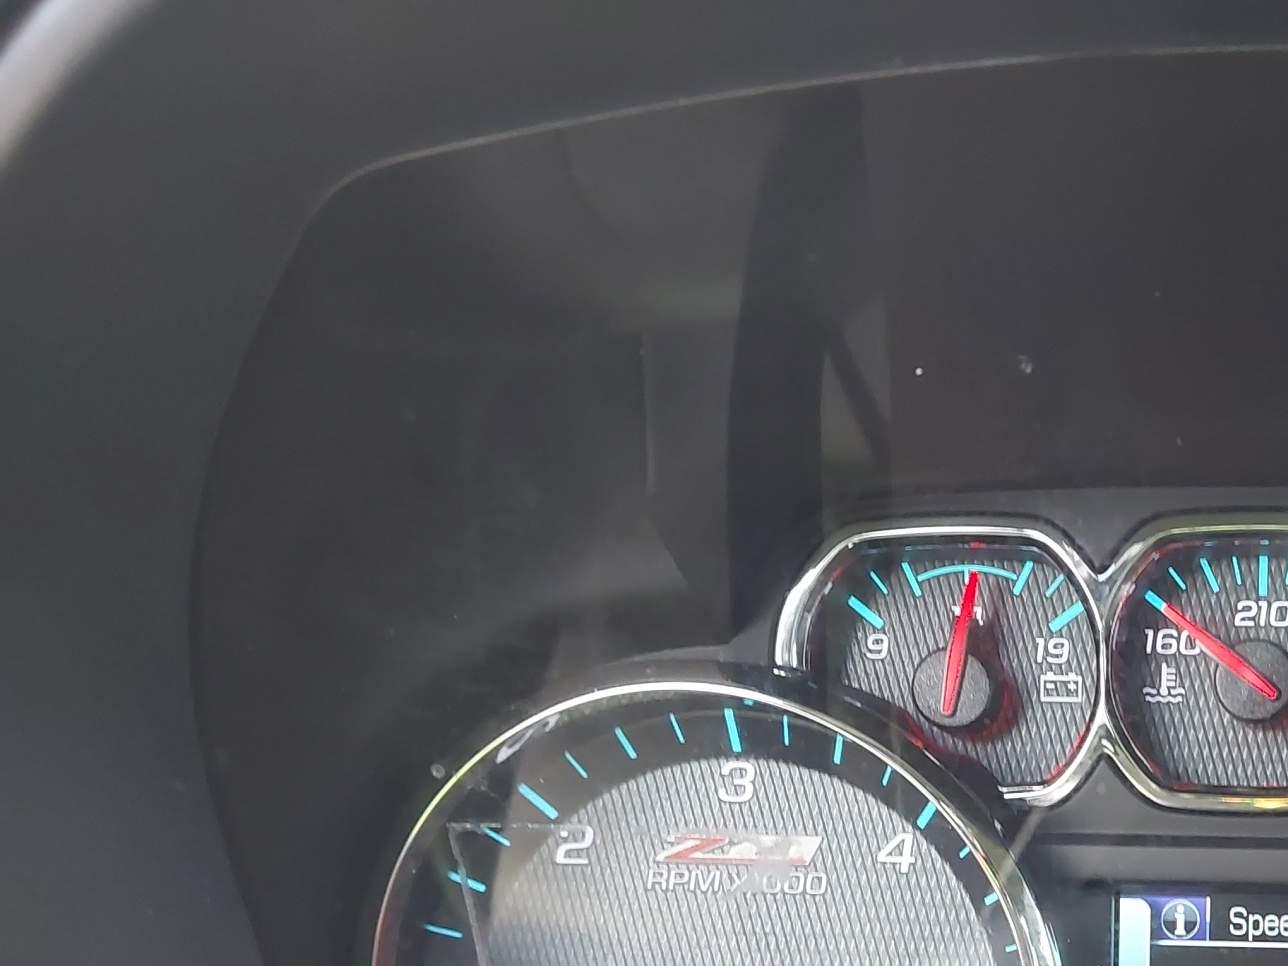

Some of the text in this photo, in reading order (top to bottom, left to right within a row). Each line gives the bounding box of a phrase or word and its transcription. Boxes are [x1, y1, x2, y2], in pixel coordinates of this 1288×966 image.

[865, 633, 890, 660] 9
[1035, 637, 1071, 665] 19
[1144, 628, 1202, 656] 160
[716, 761, 756, 803] 3
[554, 825, 595, 866] 2
[876, 832, 916, 874] 4
[647, 868, 721, 892] RPM
